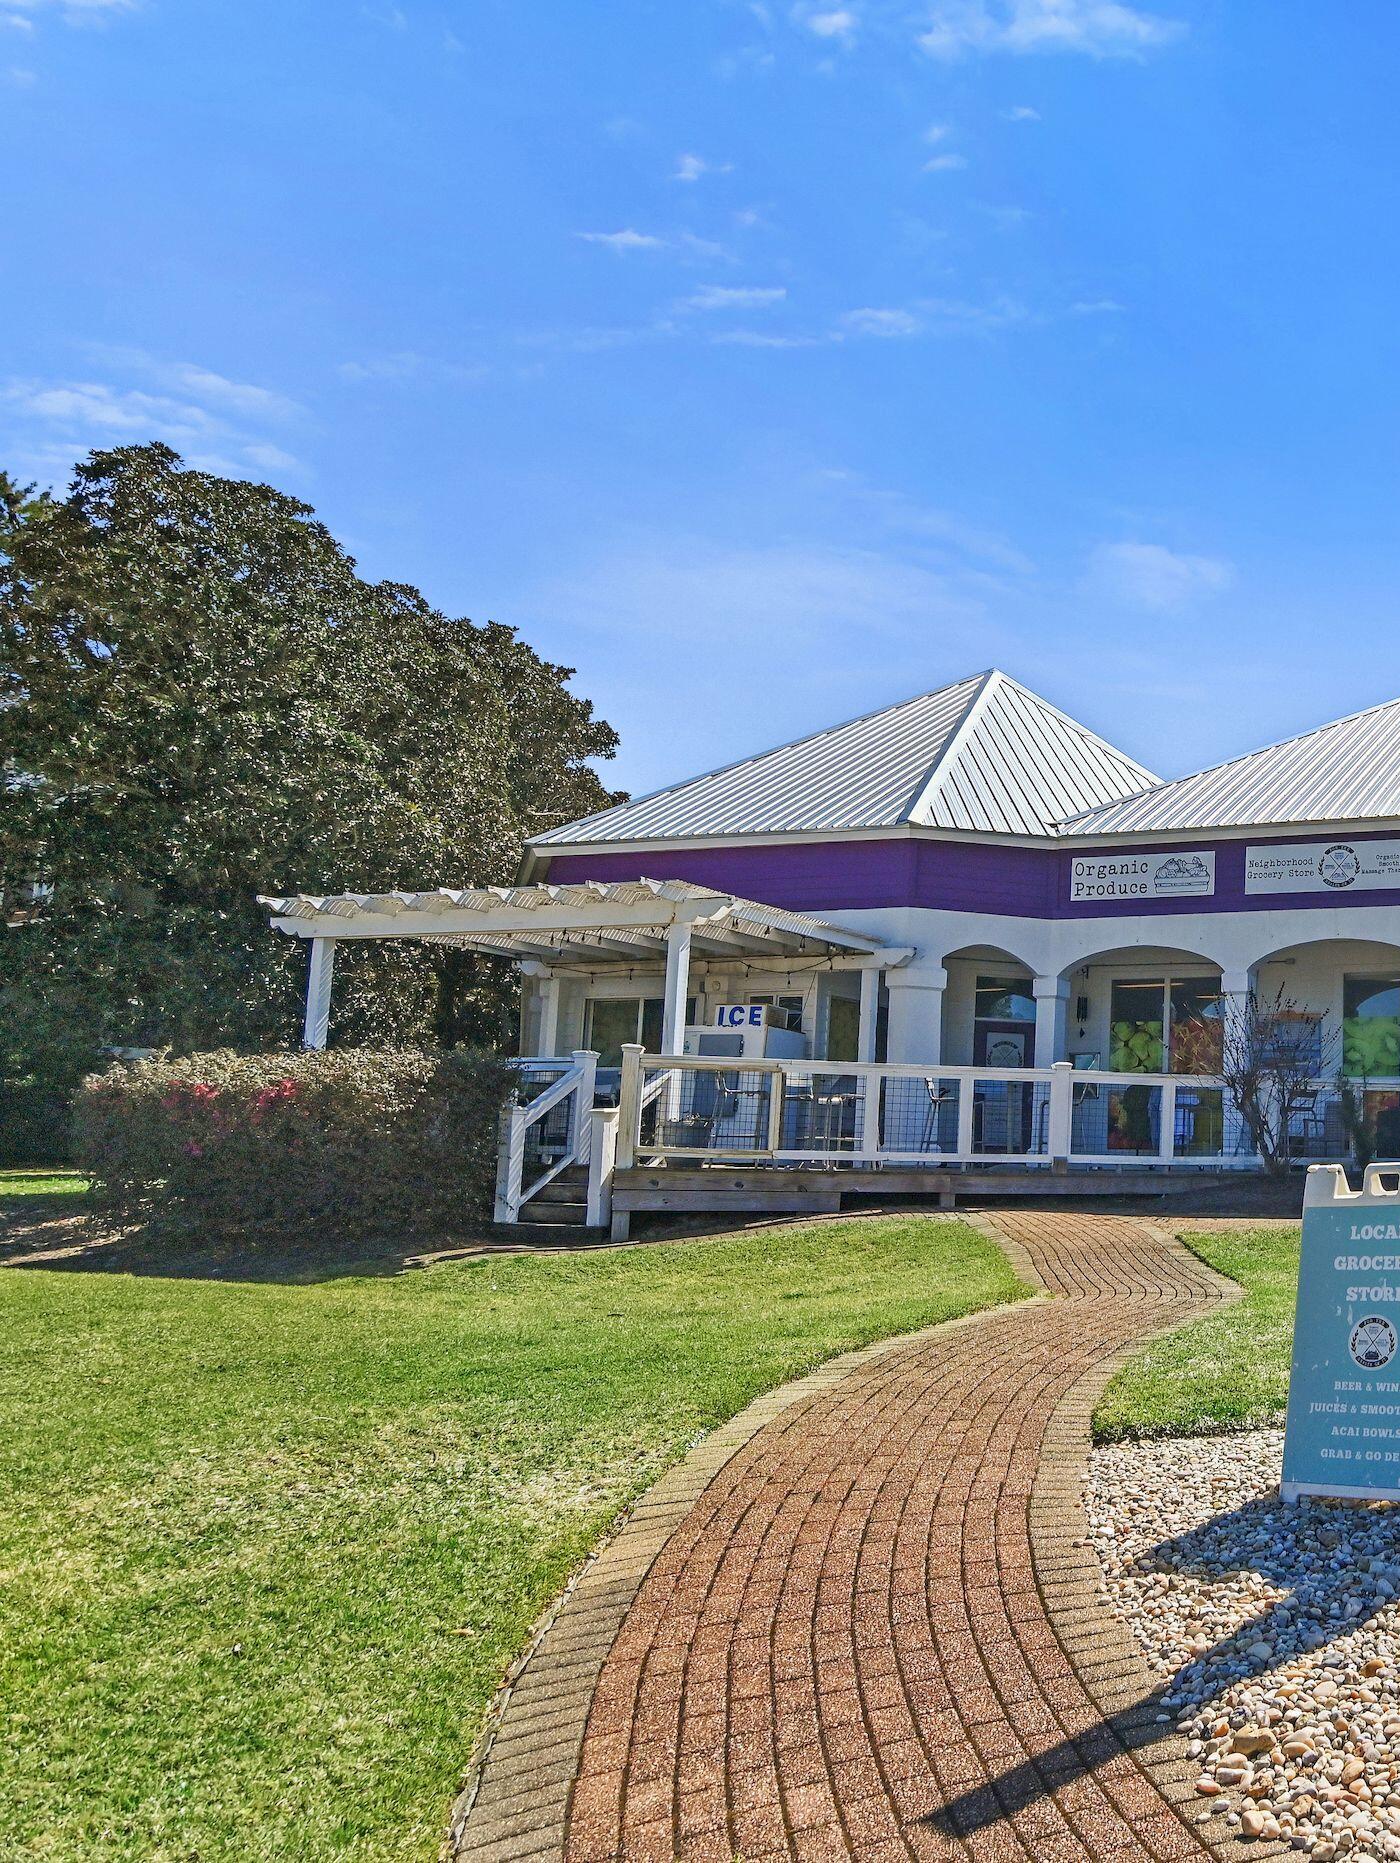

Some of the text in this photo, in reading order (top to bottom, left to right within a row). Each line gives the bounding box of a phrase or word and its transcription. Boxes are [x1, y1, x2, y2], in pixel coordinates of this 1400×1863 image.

[1075, 860, 1148, 878] Organic
[1249, 858, 1313, 869] Neighborhood
[1247, 869, 1314, 879] Grocery Store
[1074, 881, 1148, 896] Produce
[718, 1006, 762, 1026] ICE
[1334, 1381, 1362, 1391] BEER
[1366, 1383, 1372, 1392] &
[1310, 1403, 1348, 1413] JUICES
[1350, 1405, 1357, 1413] &
[1331, 1426, 1359, 1436] ACAI
[1321, 1448, 1352, 1459] GRAB
[1355, 1451, 1361, 1459] &
[1365, 1451, 1381, 1460] GO
